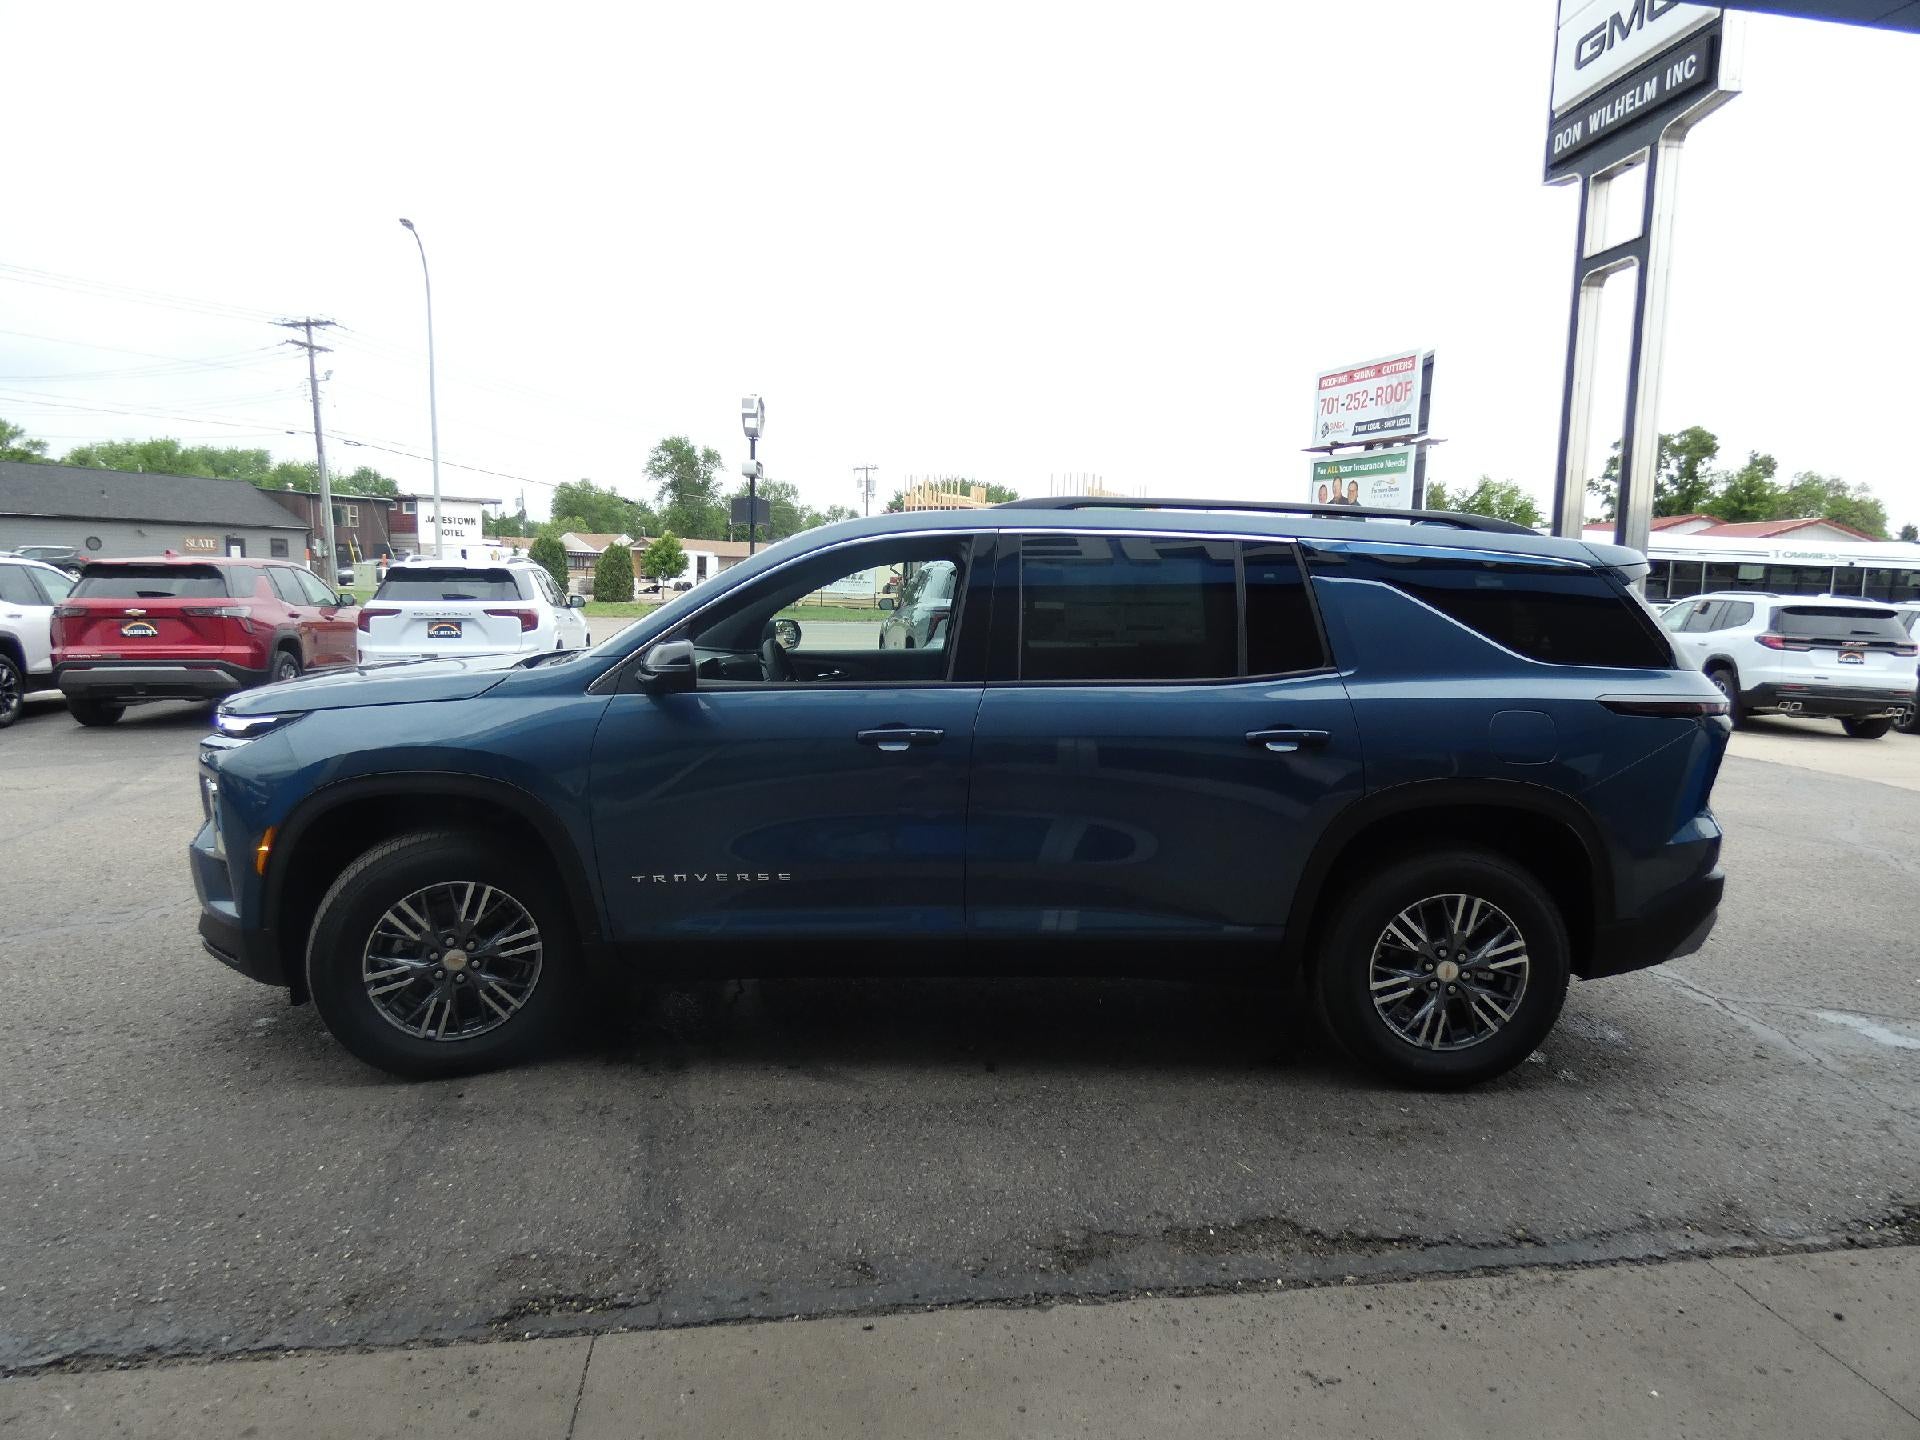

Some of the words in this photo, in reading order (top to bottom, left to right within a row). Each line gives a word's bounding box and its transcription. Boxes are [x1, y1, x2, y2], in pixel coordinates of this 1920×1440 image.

[1554, 121, 1582, 154] DON
[1589, 76, 1657, 134] WILHELM
[1665, 54, 1697, 91] INC
[1320, 381, 1413, 416] 701-252-ROOF
[1327, 465, 1339, 474] ALL
[1353, 461, 1384, 471] Insurance
[1384, 458, 1406, 468] Needs
[425, 515, 477, 526] JAESTOWN
[185, 538, 217, 548] SLATE
[631, 873, 791, 883] TRAVERSE
